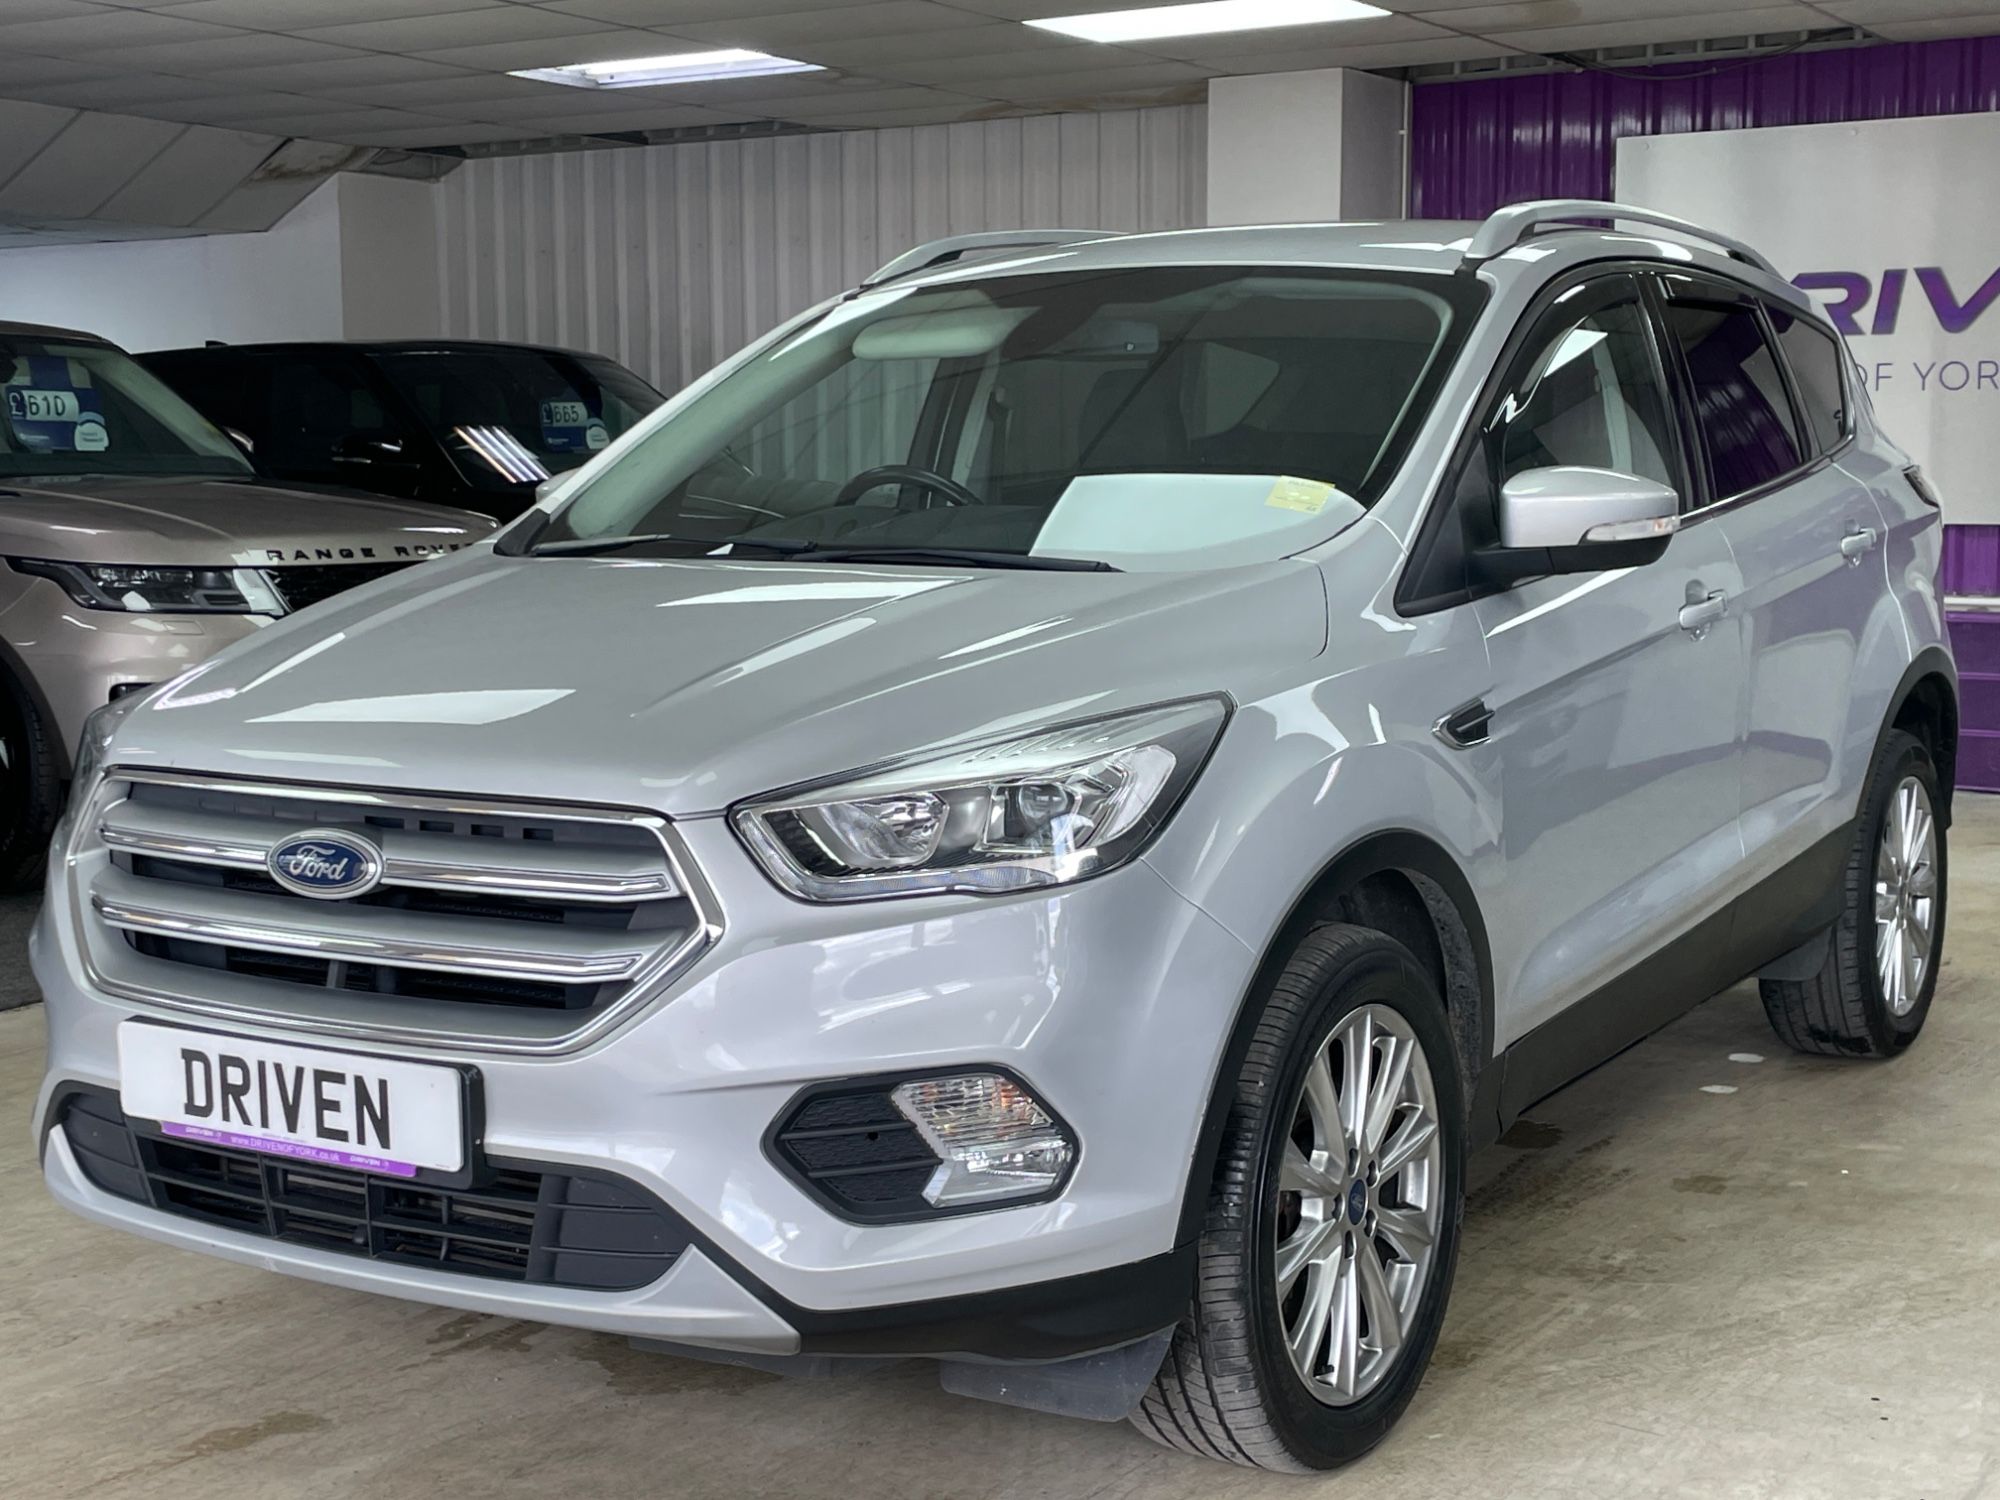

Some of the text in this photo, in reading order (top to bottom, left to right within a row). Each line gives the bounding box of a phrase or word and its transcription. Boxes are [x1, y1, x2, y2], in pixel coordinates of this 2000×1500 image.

[1912, 360, 2000, 392] YOR
[266, 547, 376, 561] RANGE
[289, 844, 349, 881] Ford
[180, 1047, 391, 1150] DRIVEN
